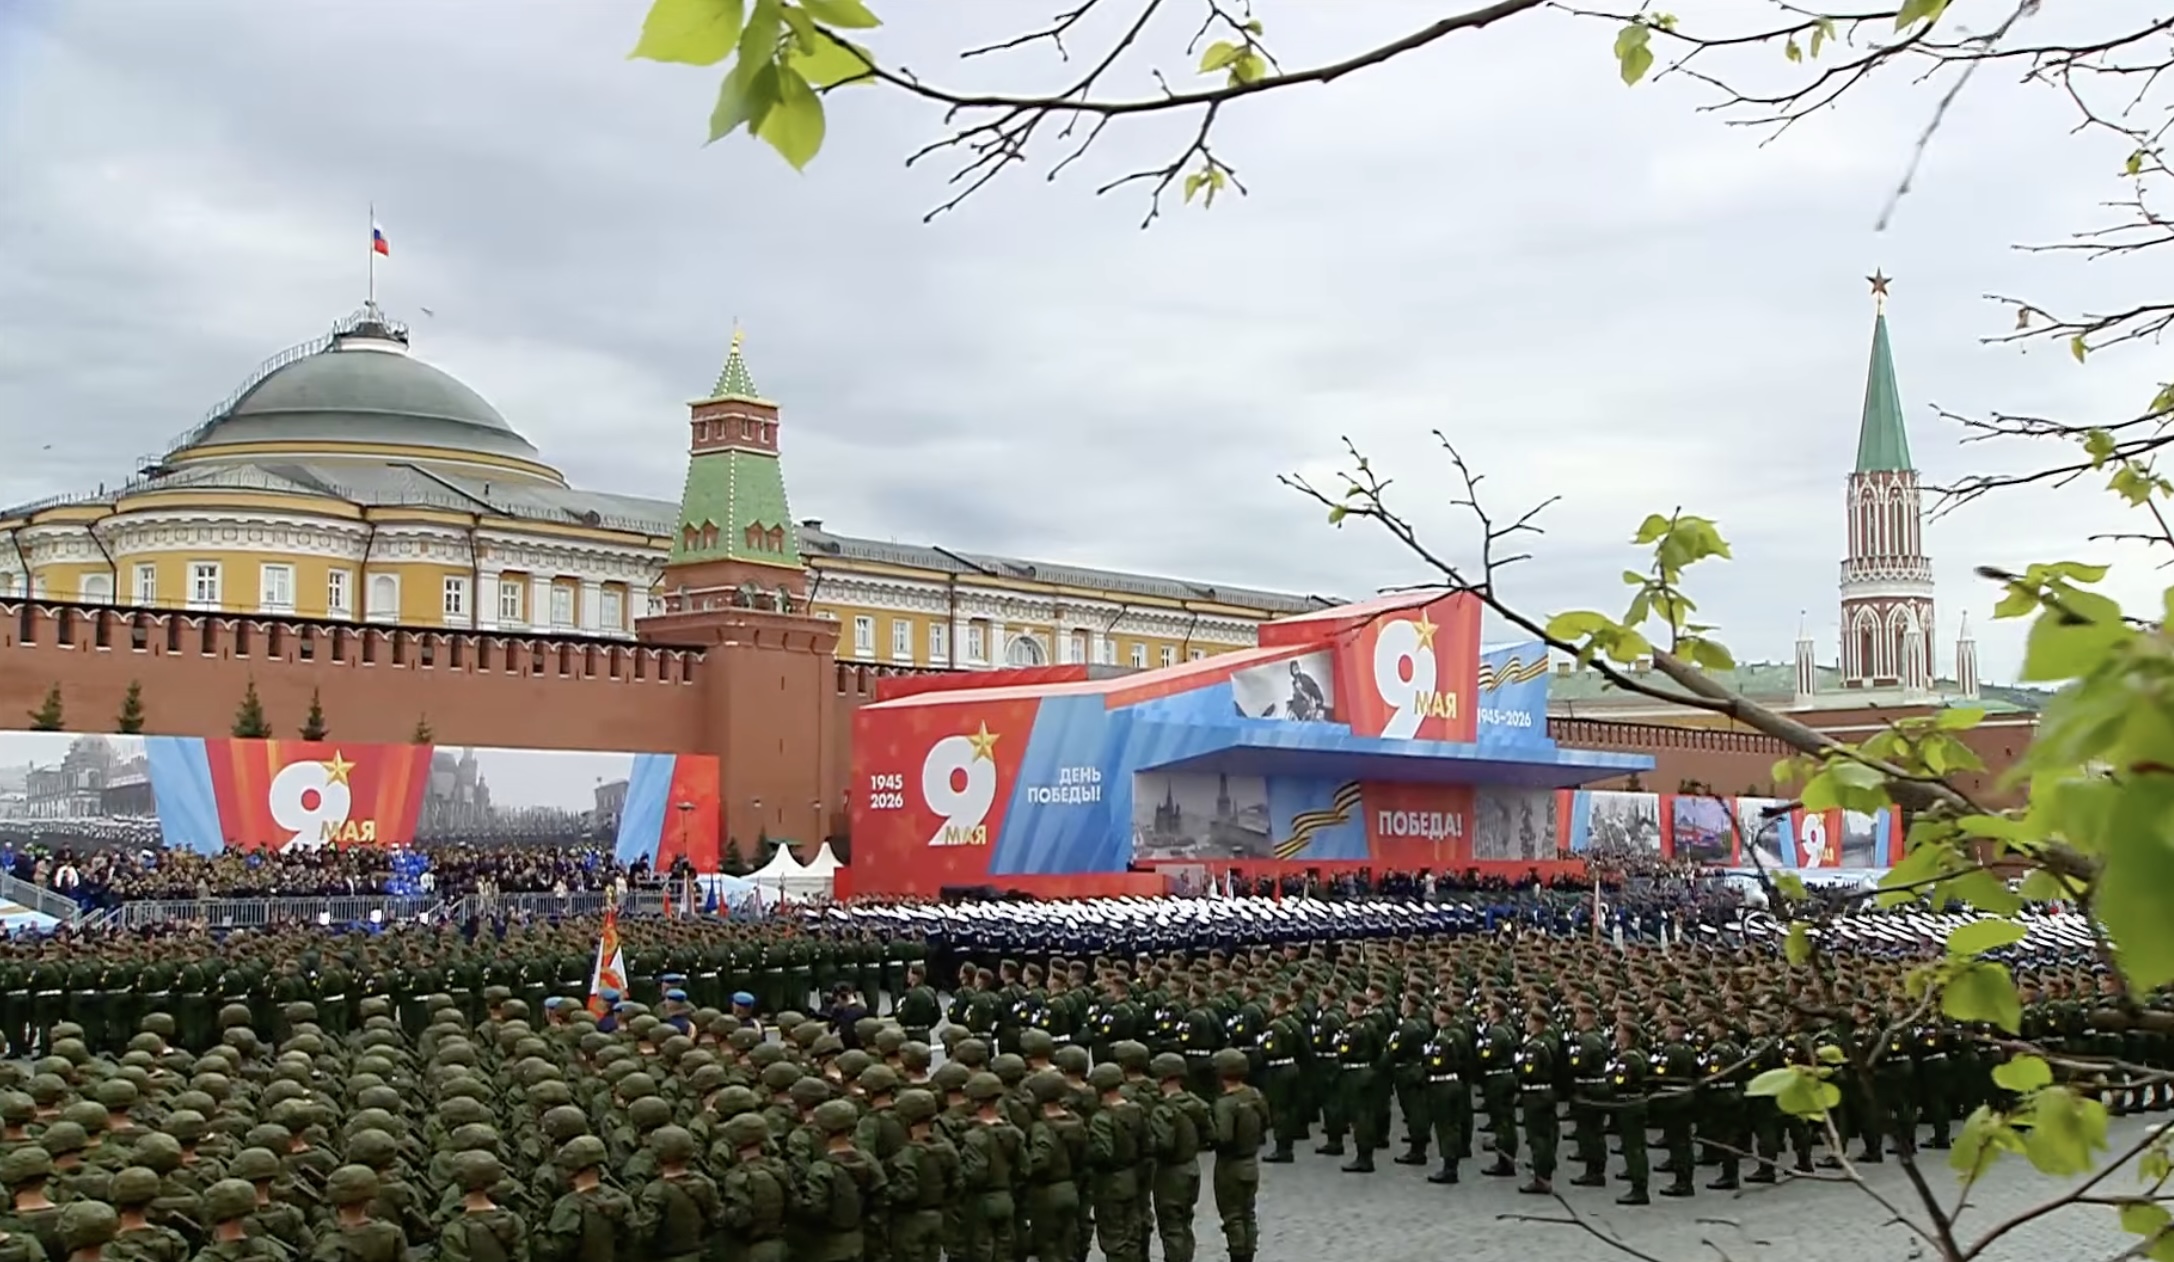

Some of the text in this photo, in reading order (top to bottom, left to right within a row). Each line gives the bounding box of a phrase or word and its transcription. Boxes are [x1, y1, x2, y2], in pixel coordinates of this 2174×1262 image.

[1374, 619, 1457, 740] 9 МАЯ
[870, 774, 903, 790] 1945
[923, 735, 996, 846] 9 МАЯ
[1059, 767, 1102, 785] ДЕНЬ
[269, 760, 376, 854] 9 МАЯ
[870, 792, 904, 809] 2026
[1027, 785, 1102, 804] ПОБЕДЫ!
[1378, 810, 1463, 840] ПОБЕДА!
[1802, 813, 1826, 868] 9
